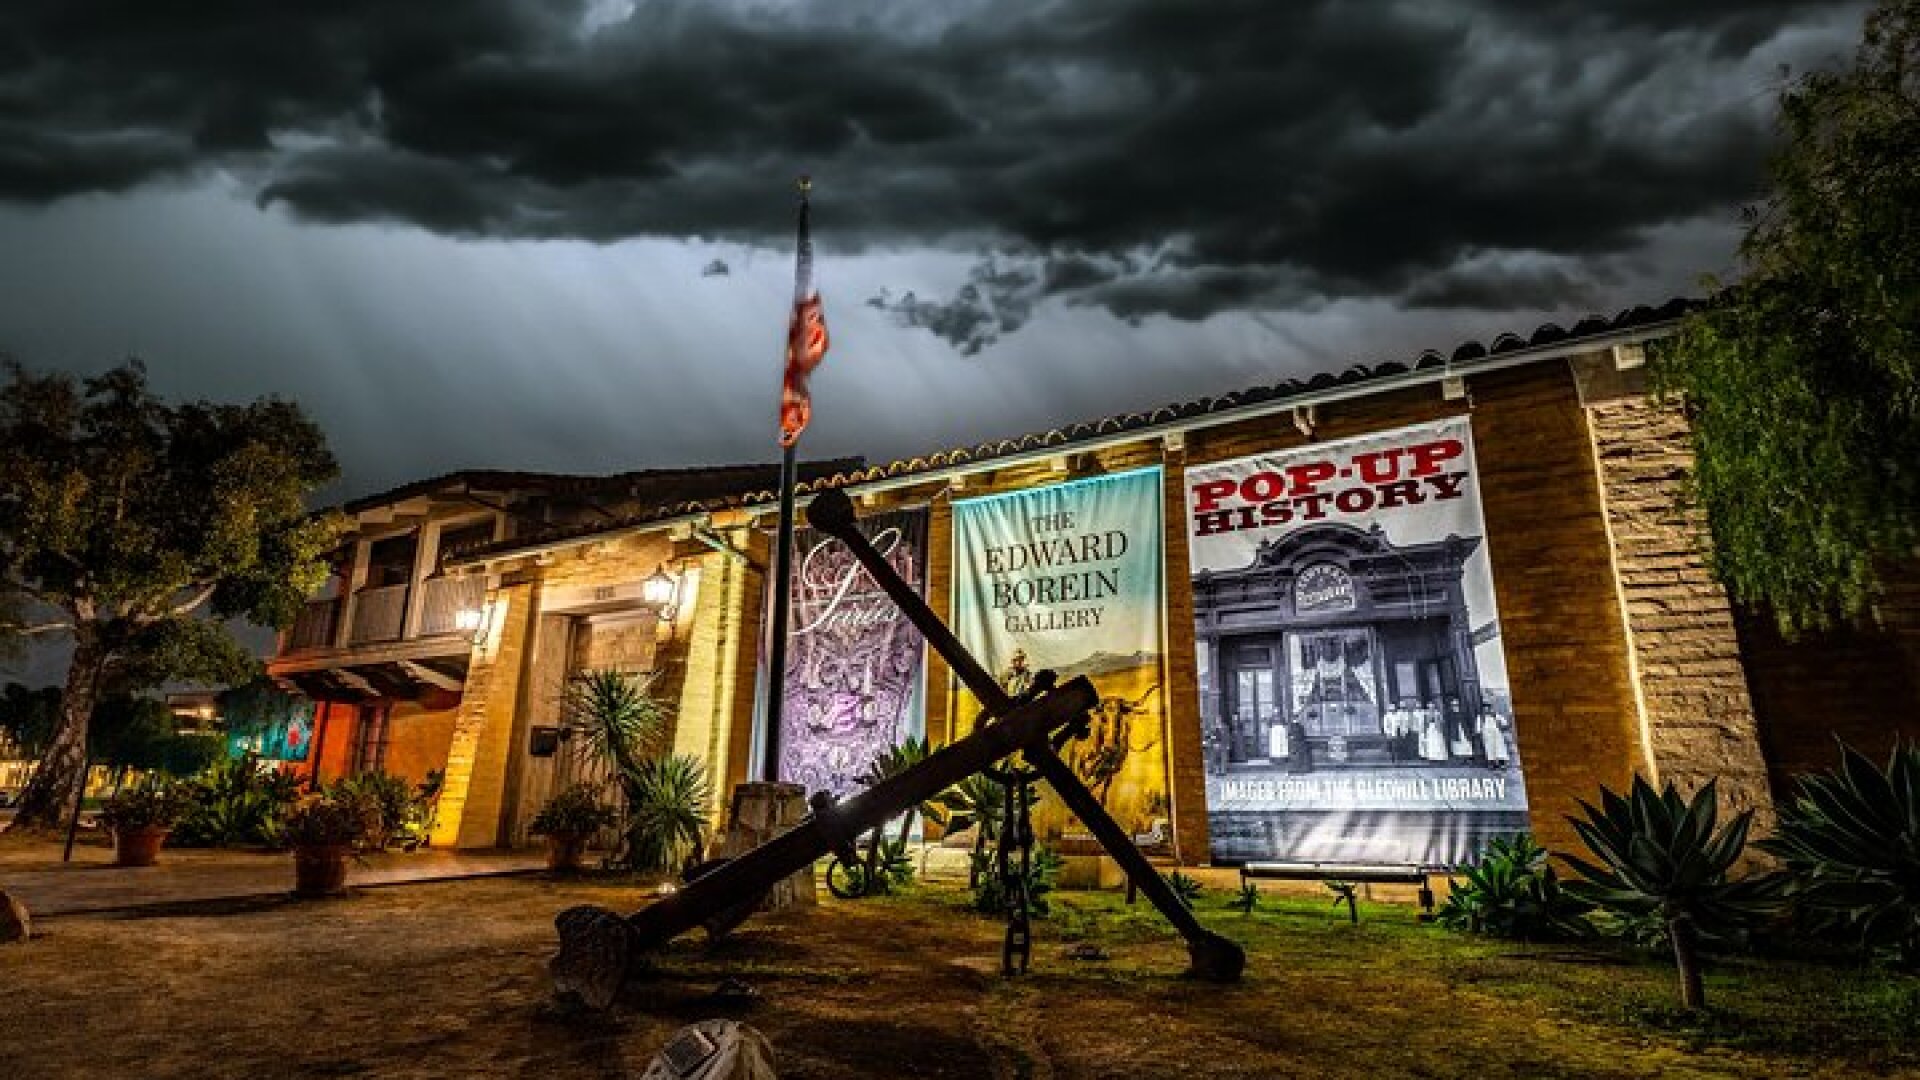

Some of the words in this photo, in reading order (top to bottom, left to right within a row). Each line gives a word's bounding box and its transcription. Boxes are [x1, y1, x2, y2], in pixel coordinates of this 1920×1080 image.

[1191, 439, 1465, 513] POP-UP
[1032, 511, 1076, 534] THE
[1194, 471, 1469, 537] HISTORY
[986, 530, 1129, 574] EDWARD
[992, 567, 1121, 609] BOREIN
[1004, 607, 1105, 633] GALLERY
[1220, 780, 1275, 801] IMAGES
[1277, 779, 1320, 801] FROM
[1322, 779, 1354, 801] THE
[1432, 778, 1506, 801] LIBRARY
